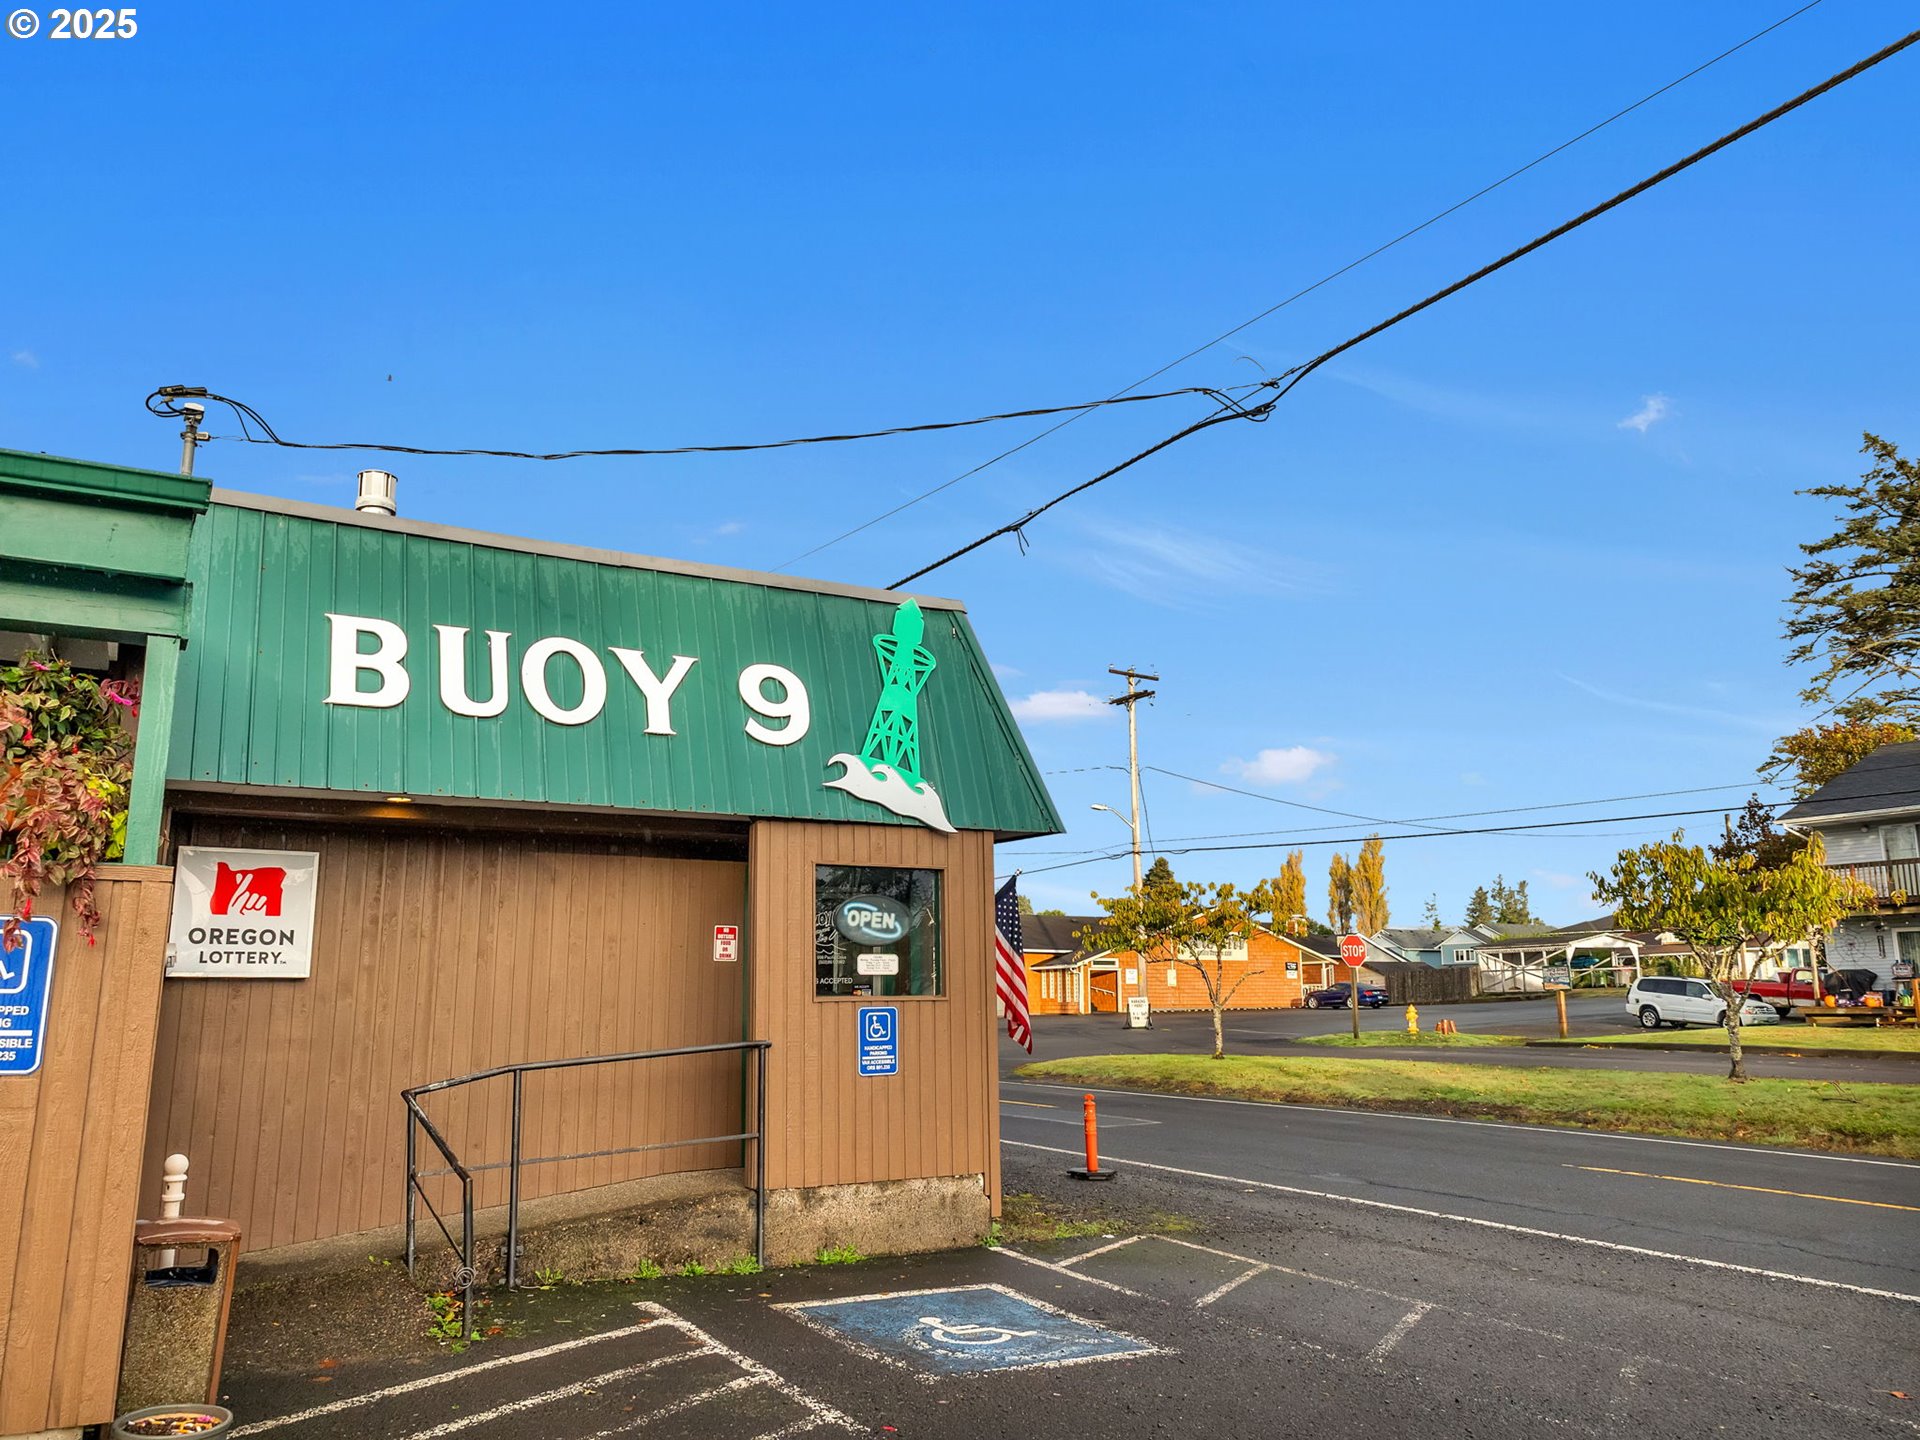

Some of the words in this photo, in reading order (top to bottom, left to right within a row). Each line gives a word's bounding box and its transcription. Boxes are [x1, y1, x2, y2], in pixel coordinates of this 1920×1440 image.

[323, 613, 699, 736] BUOY
[738, 663, 811, 747] 9
[847, 910, 896, 929] OPEN
[188, 927, 295, 945] OREGON
[199, 951, 282, 964] LOTTERY
[1342, 945, 1365, 957] STOP
